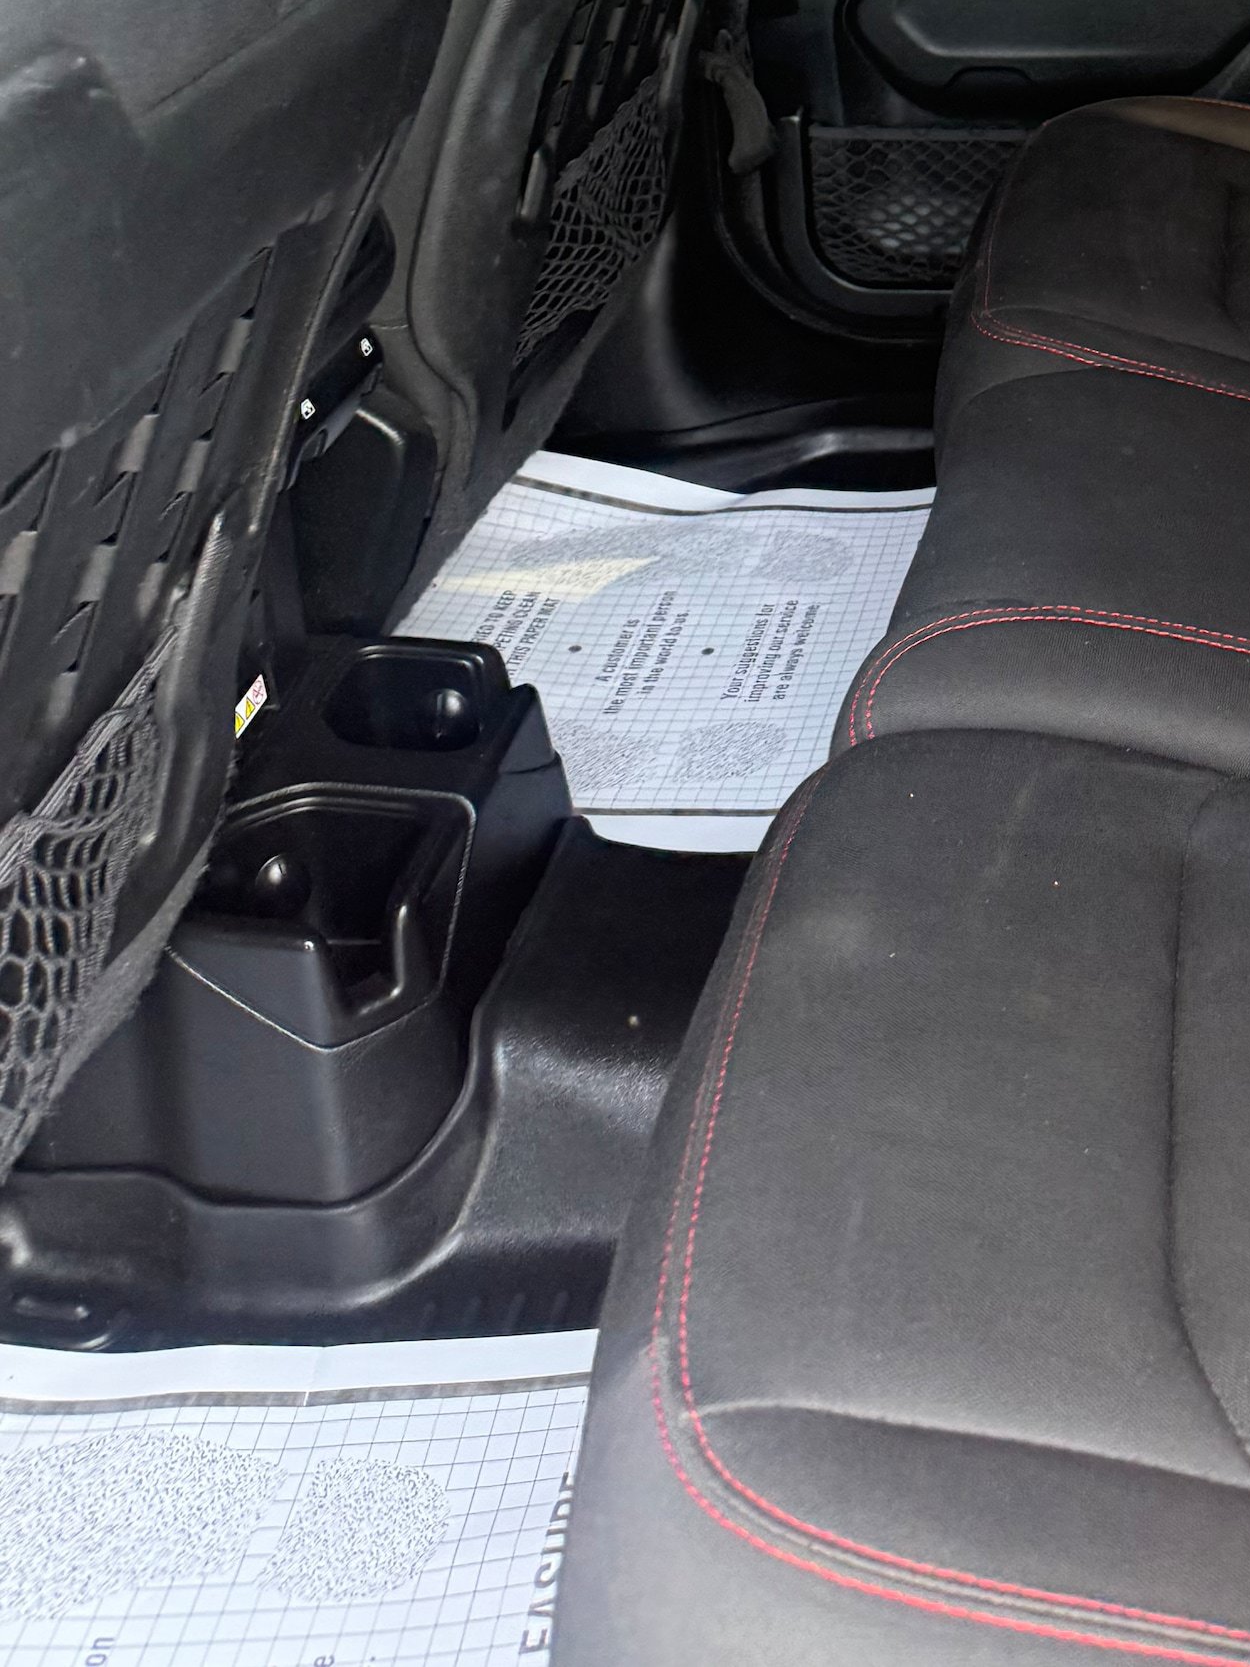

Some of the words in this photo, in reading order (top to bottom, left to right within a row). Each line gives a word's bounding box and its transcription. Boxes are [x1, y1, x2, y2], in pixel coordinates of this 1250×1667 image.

[493, 590, 515, 610] KEEP
[484, 613, 504, 622] TO
[776, 600, 799, 634] service
[471, 625, 495, 641] RIED
[493, 620, 523, 649] PETING
[506, 646, 531, 664] THIS
[520, 617, 549, 644] PAPER
[665, 626, 683, 636] to
[768, 636, 785, 651] our
[602, 630, 634, 673] customer
[623, 619, 640, 627] is
[603, 699, 624, 714] the
[615, 672, 638, 696] most
[627, 624, 662, 669] important
[652, 591, 677, 622] person
[654, 638, 677, 665] world
[720, 677, 744, 700] Your
[735, 618, 768, 674] suggestions
[755, 604, 775, 616] for
[643, 668, 664, 682] the
[744, 654, 781, 702] improving
[779, 649, 804, 681] always
[636, 685, 655, 694] in
[773, 684, 790, 700] are
